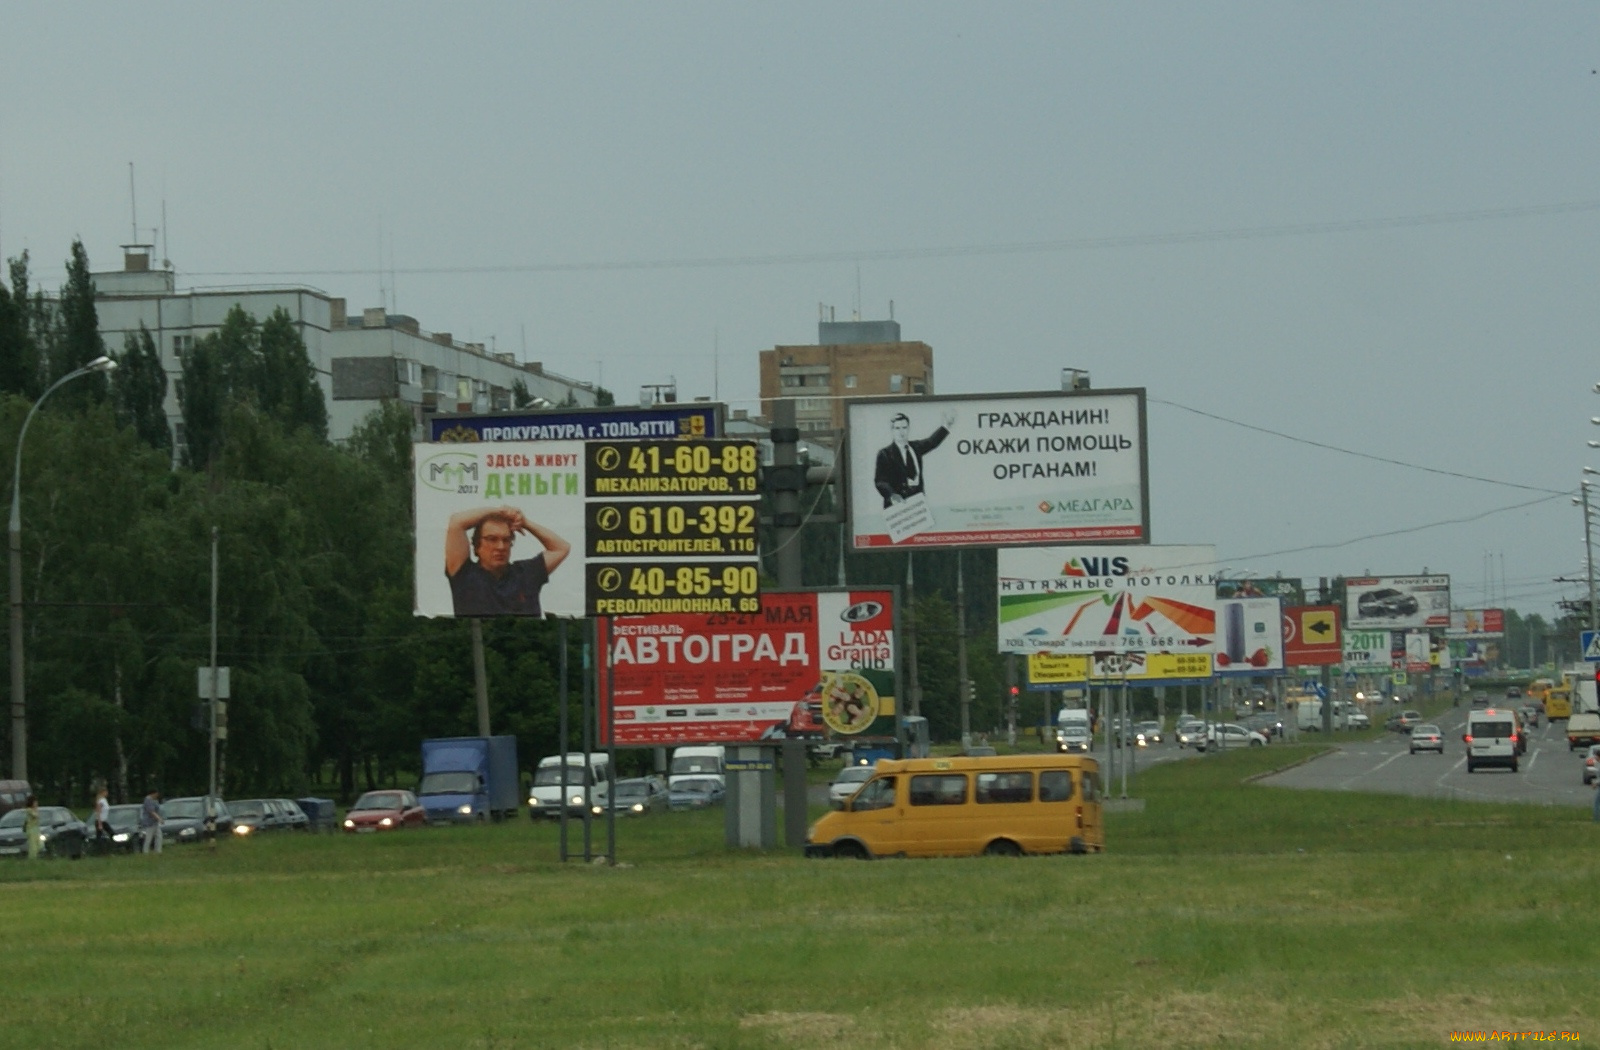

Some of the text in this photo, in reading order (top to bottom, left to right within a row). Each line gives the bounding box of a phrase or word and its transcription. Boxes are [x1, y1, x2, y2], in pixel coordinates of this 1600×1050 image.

[978, 409, 1109, 428] ГРАЖДАНИН!
[482, 423, 584, 441] ПРОКУРАТУРА
[957, 434, 1132, 455] ОКАЖИ ПОМОЩЬ
[486, 454, 578, 468] ЗДЕСЬ ЖИВУТ
[628, 445, 757, 474] 41-60-88
[993, 461, 1097, 480] ОРГАНАМ!
[457, 485, 479, 494] 2011
[484, 472, 578, 499] ДЕНЬГИ
[595, 476, 757, 493] МЕХАНИЗАТОРОВ, 19
[1058, 498, 1134, 512] МЕДГАРД
[629, 505, 755, 534] 610-392
[596, 537, 725, 553] АВТОСТРОИТЕЛЕЙ,
[629, 566, 758, 595] 40-85-90
[1002, 572, 1217, 590] натяжные потолки
[597, 597, 759, 613] РЕВОЛЮЦИОННАЯ, 66
[765, 605, 812, 624] МАЯ
[613, 624, 684, 637] ФЕСТИВАЛЬ
[840, 631, 890, 646] LADA
[613, 632, 809, 666] АВТОГРАД
[827, 644, 890, 661] Granta
